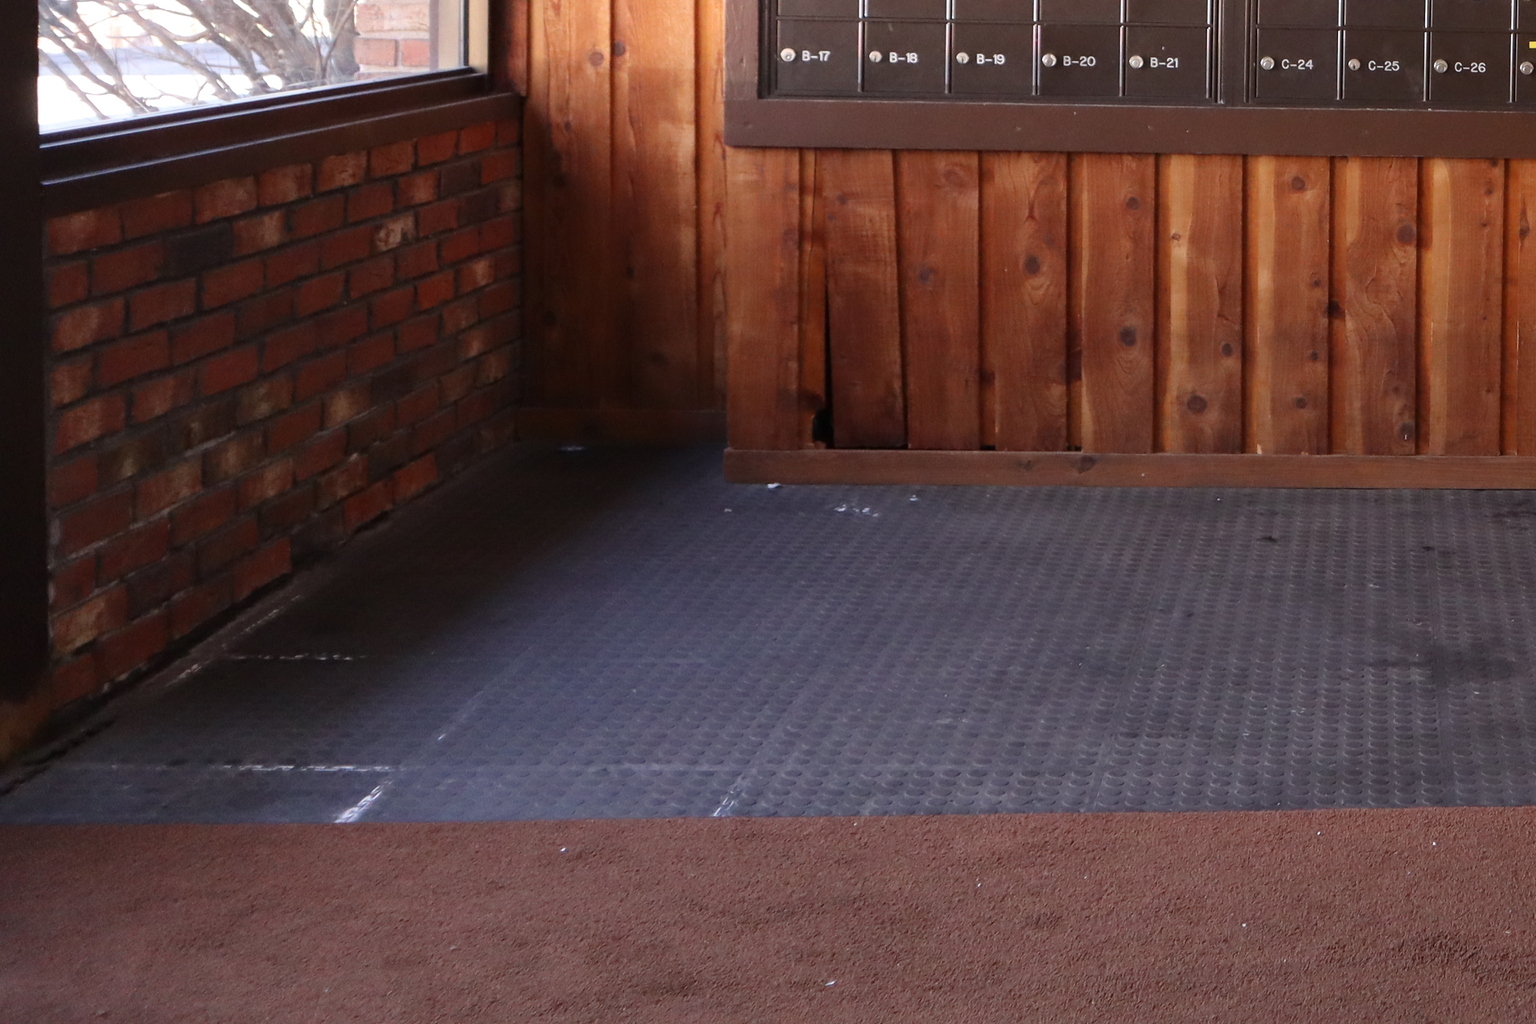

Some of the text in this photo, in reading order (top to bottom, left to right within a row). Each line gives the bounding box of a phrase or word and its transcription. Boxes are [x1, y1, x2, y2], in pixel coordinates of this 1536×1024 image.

[802, 51, 830, 61] B-17
[890, 52, 917, 63] B-18
[977, 54, 1005, 64] B-19
[1064, 56, 1095, 66] B-20
[1151, 57, 1178, 68] B-21
[1282, 59, 1313, 69] C-24
[1369, 61, 1399, 71] C-25
[1455, 62, 1486, 72] C-26
